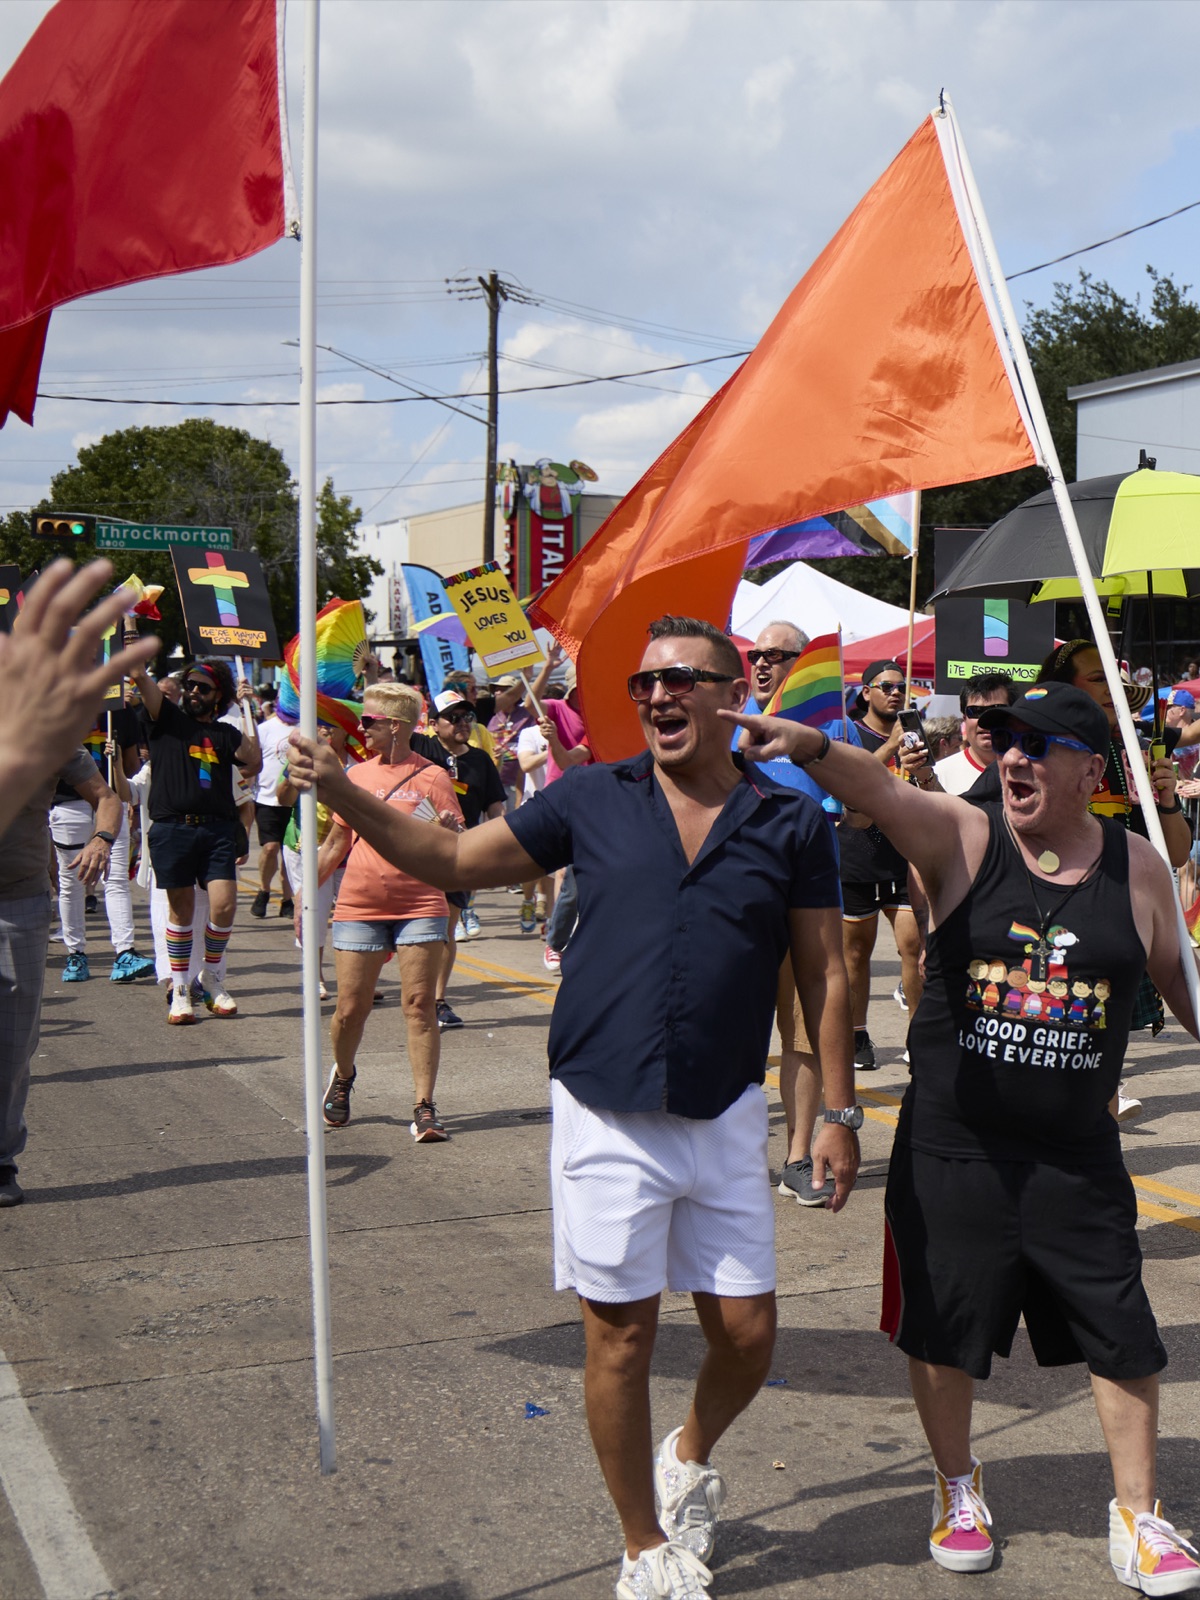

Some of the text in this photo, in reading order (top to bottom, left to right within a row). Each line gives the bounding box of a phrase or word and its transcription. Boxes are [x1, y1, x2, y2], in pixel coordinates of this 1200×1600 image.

[99, 525, 231, 543] Throckmorton
[542, 524, 565, 588] ITAL
[459, 586, 511, 614] JESUS
[473, 612, 508, 631] LOVES
[213, 636, 231, 644] FOR
[503, 629, 527, 643] YOU
[975, 1016, 1027, 1042] GOOD
[958, 1029, 1103, 1070] LOVE EVERYONE
